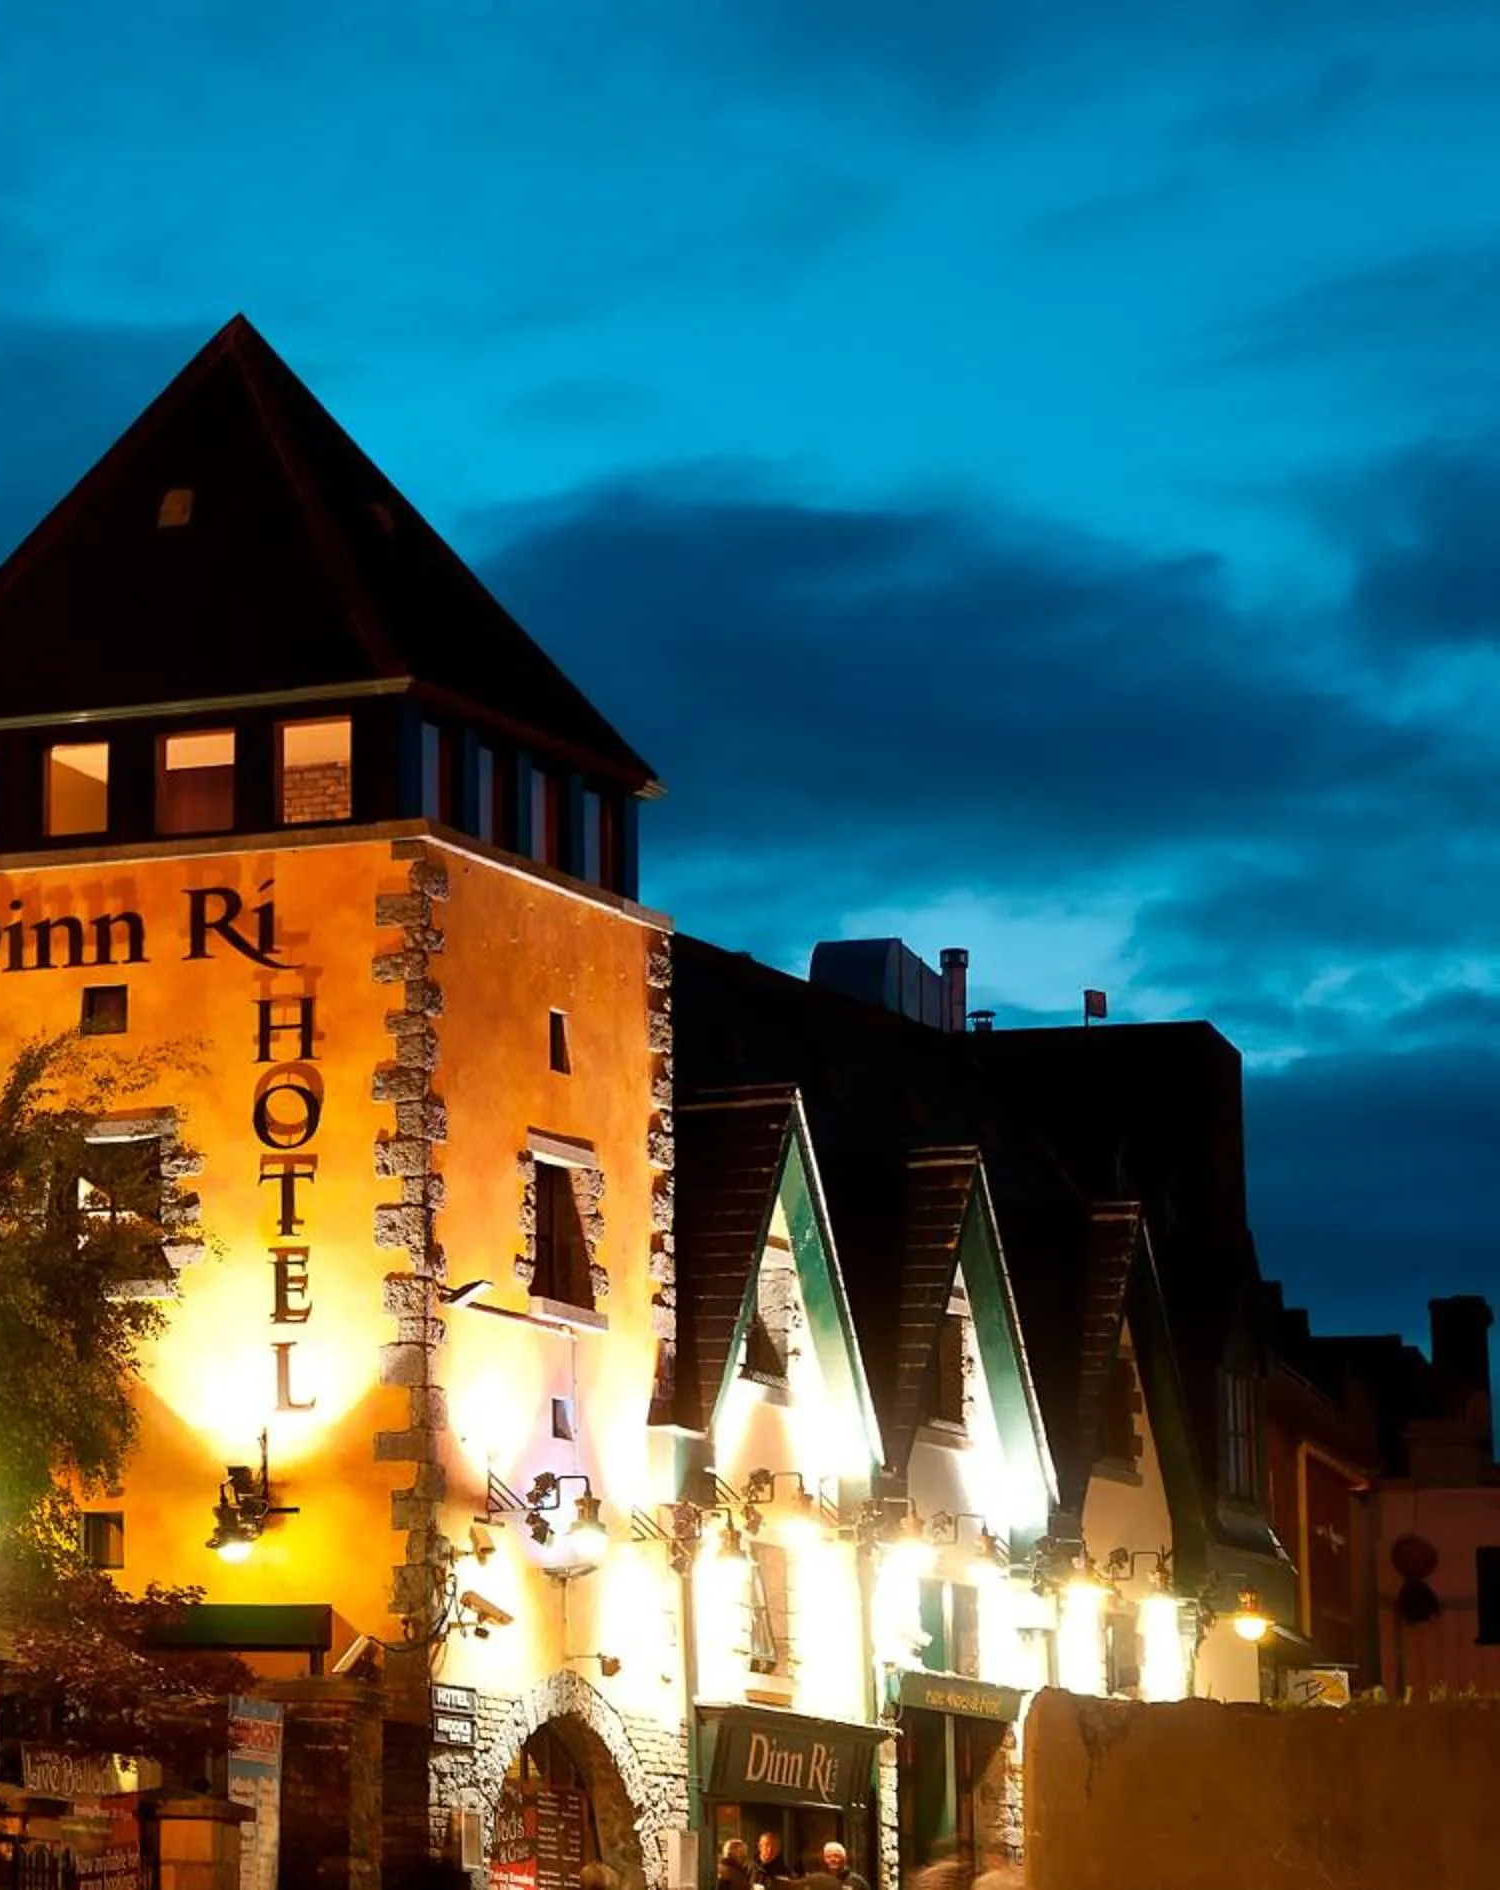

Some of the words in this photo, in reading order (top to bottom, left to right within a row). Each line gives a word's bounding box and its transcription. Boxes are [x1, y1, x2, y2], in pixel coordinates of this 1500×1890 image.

[182, 880, 300, 969] Rí
[253, 997, 321, 1413] HOTEL
[745, 1733, 803, 1789] Dinn
